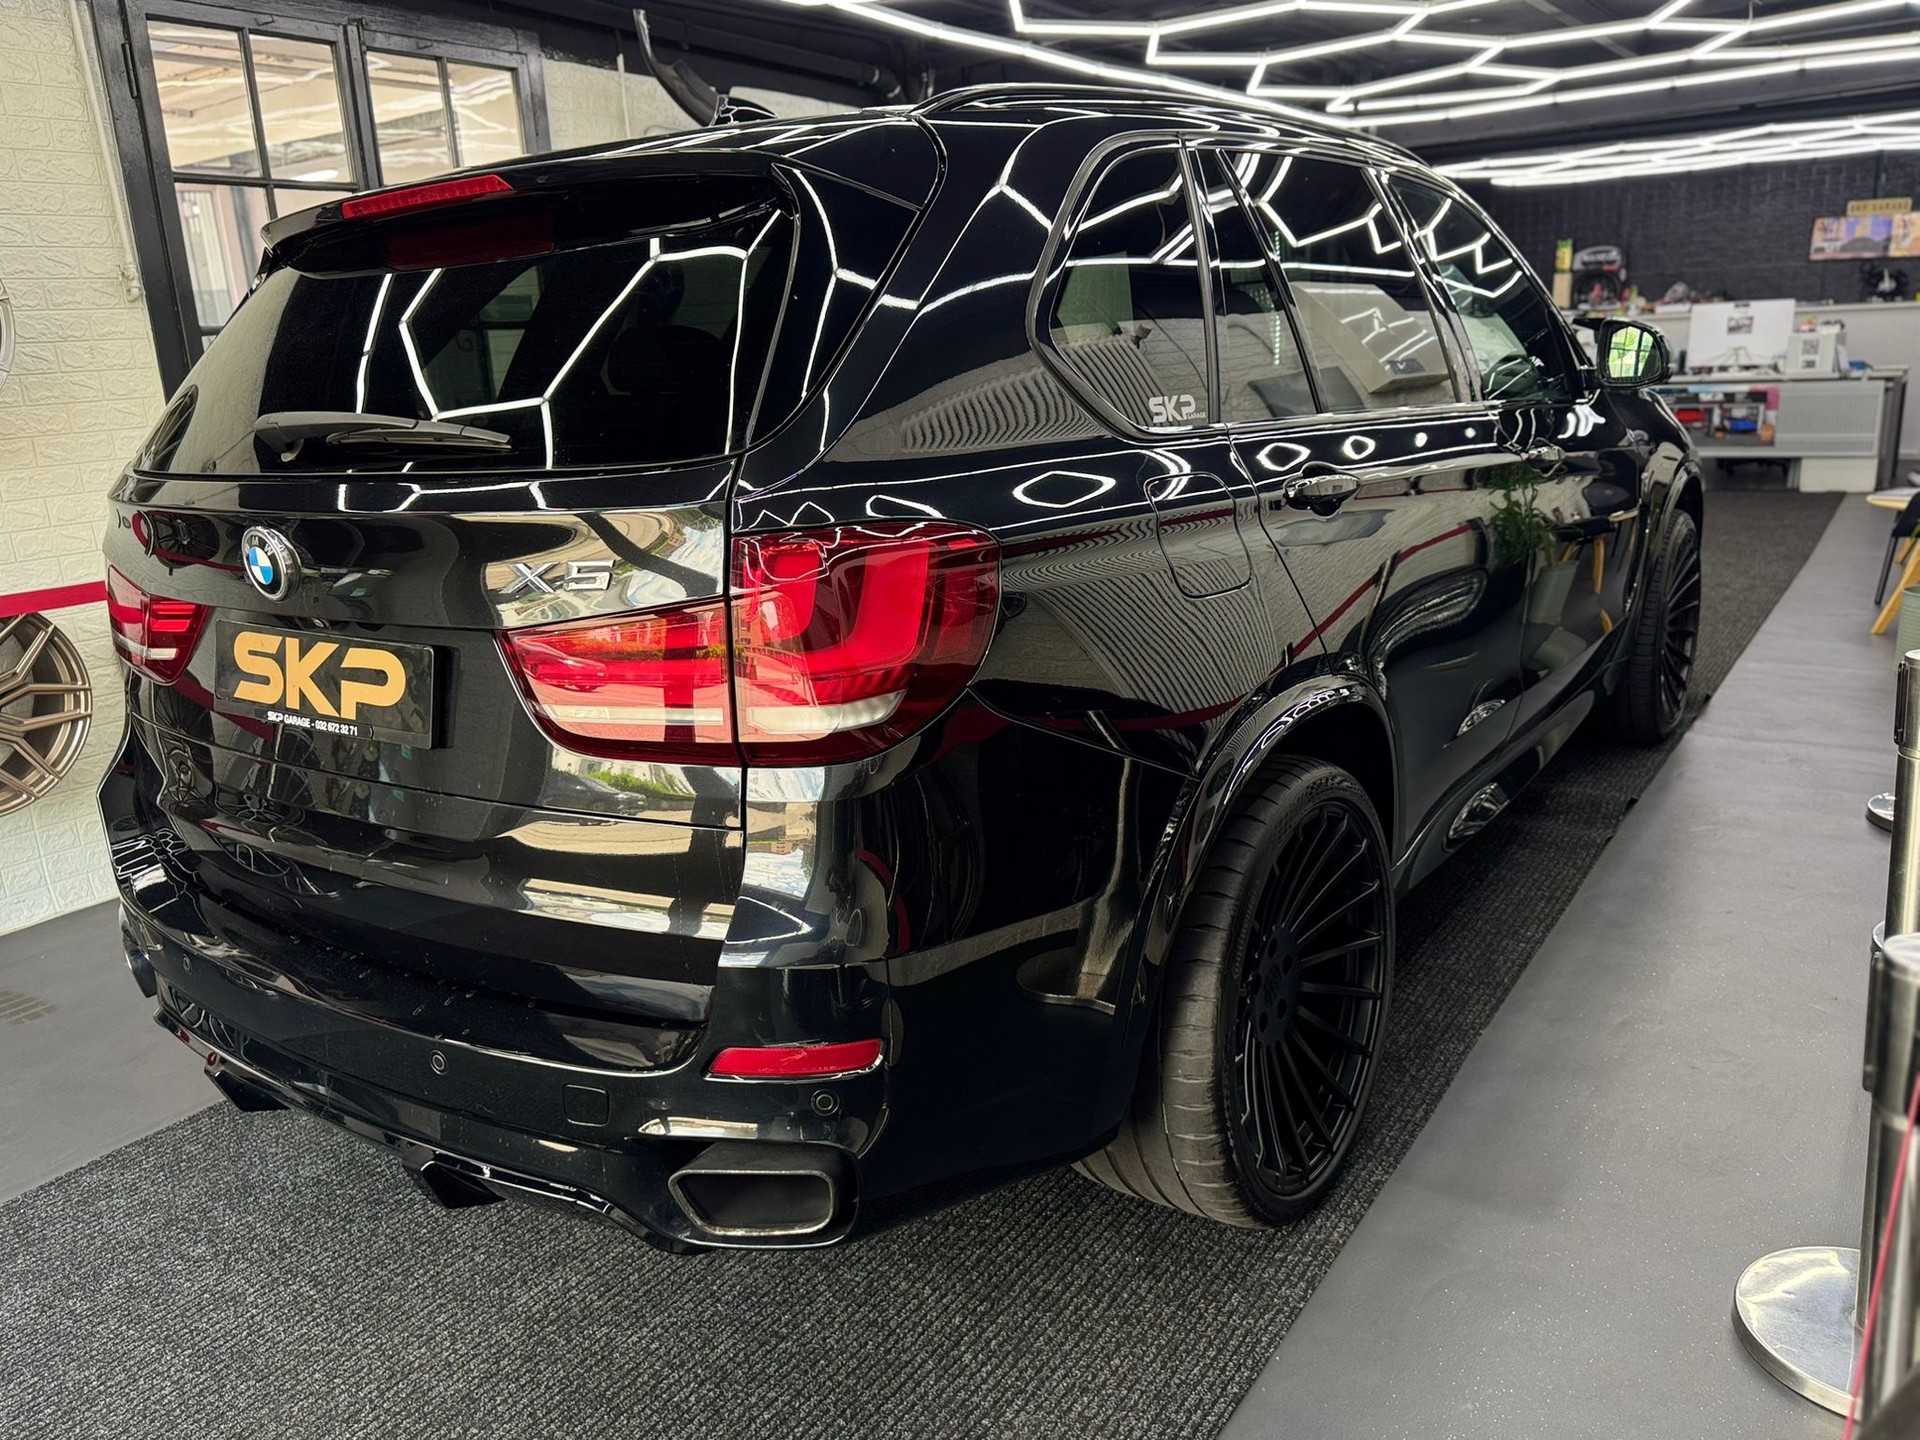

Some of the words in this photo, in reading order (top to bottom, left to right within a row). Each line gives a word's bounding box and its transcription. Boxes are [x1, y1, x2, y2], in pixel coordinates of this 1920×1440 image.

[1149, 394, 1195, 423] SKP
[245, 536, 275, 557] BMW
[499, 560, 615, 594] X5
[233, 631, 407, 720] SKP
[267, 711, 283, 722] SKP
[284, 715, 311, 728] GARAGE
[315, 720, 327, 731] 032
[327, 722, 339, 733] 672
[340, 724, 349, 734] 32
[350, 726, 357, 736] 71
